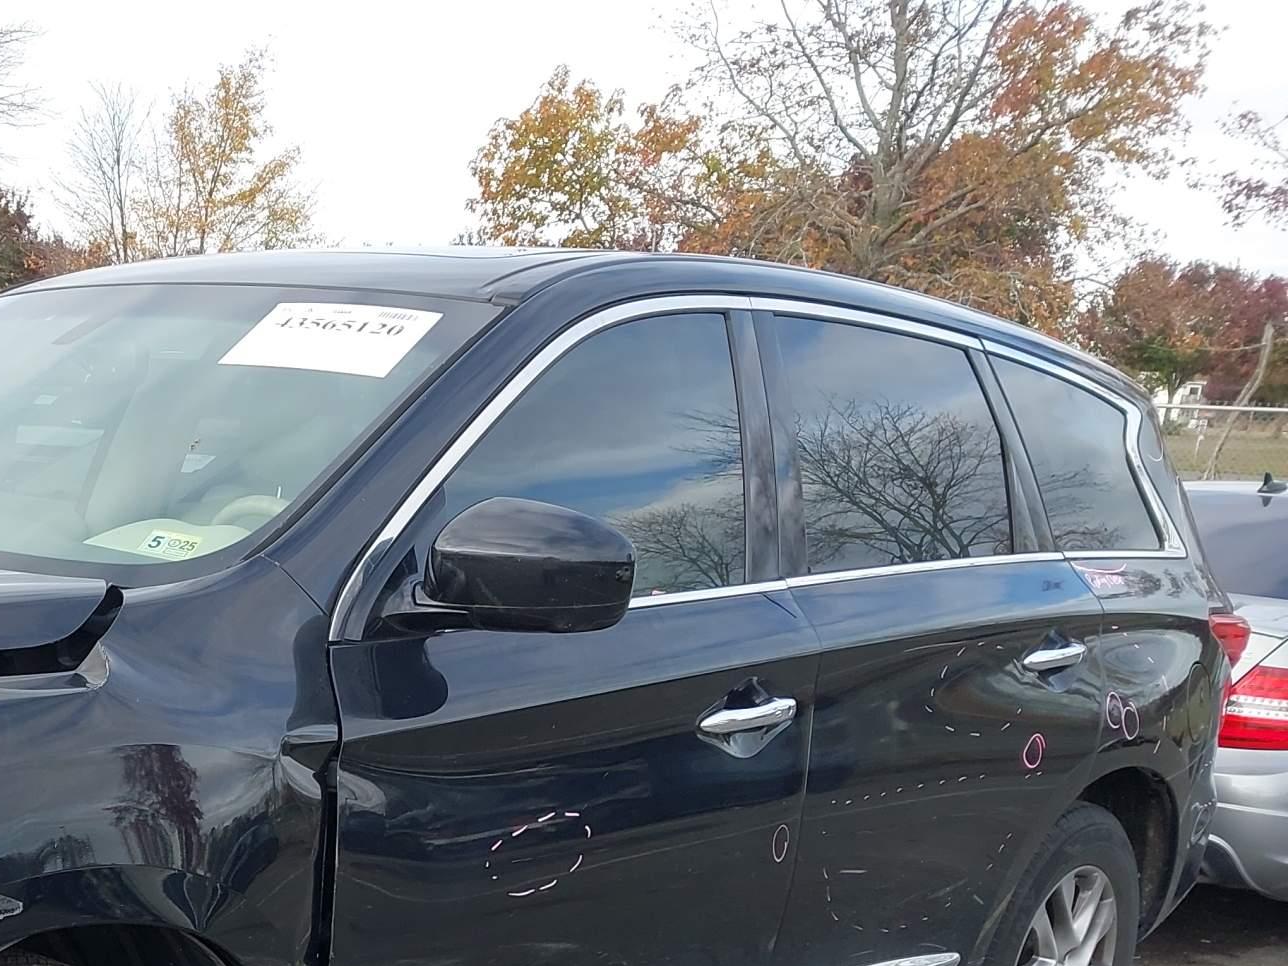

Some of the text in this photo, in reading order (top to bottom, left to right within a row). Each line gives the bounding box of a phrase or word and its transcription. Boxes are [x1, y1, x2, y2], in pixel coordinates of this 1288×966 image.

[274, 316, 405, 336] 43565120
[147, 535, 199, 551] 5 25
